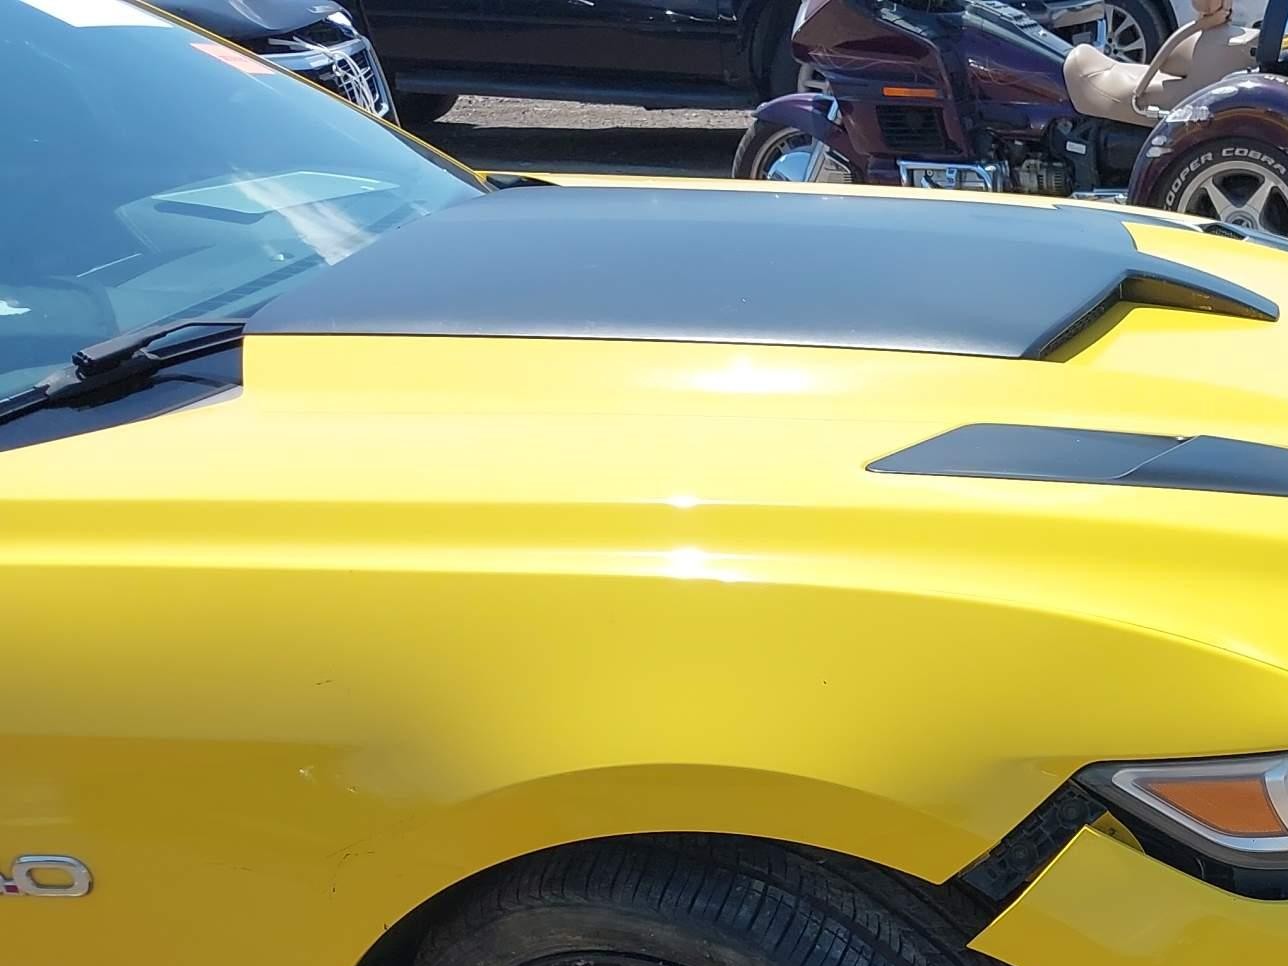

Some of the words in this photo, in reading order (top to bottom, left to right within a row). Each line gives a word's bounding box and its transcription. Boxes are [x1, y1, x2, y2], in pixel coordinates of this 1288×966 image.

[1164, 152, 1213, 212] OOPER
[1221, 147, 1287, 175] COBRA
[0, 854, 93, 897] .0
